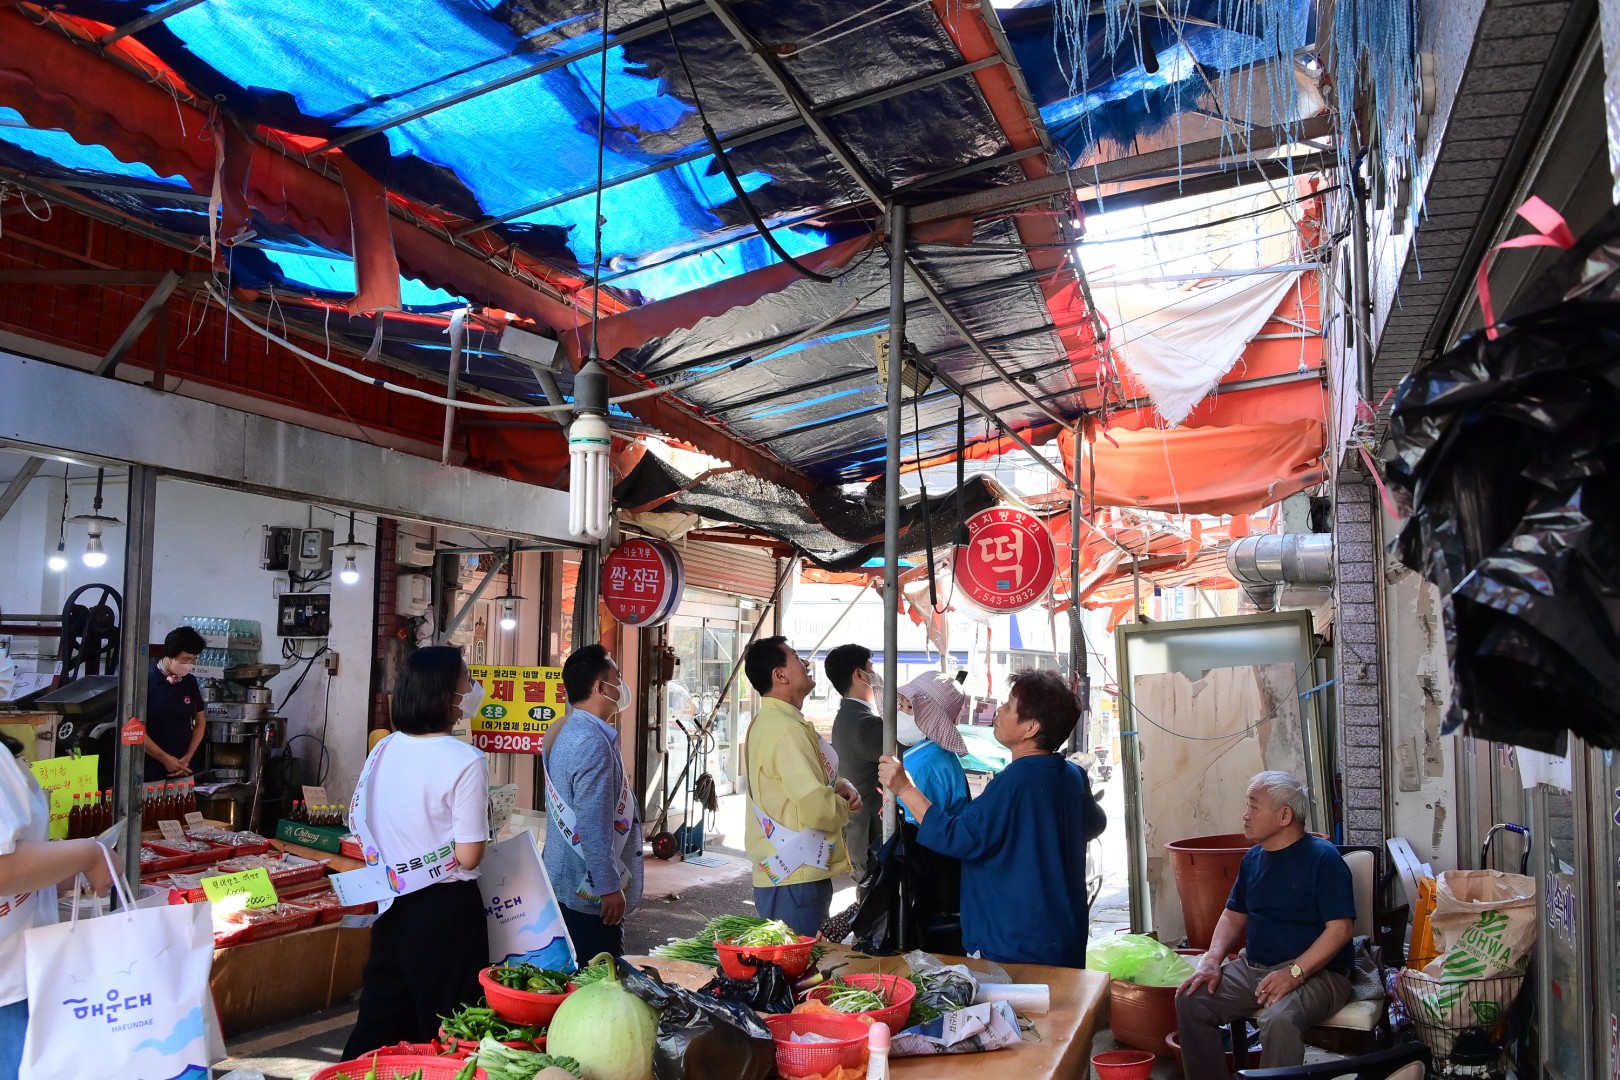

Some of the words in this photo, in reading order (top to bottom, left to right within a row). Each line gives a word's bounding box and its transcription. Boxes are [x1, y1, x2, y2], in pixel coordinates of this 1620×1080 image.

[968, 511, 1040, 535] 잔치방앗간
[623, 547, 651, 558] 미숫가루
[977, 527, 1024, 588] 떡
[972, 586, 1036, 605] T.543-8832
[493, 670, 517, 679] 필리핀
[523, 671, 539, 679] 네팔
[545, 672, 564, 680] 캄보
[485, 706, 504, 718] 초혼
[532, 707, 552, 720] 재혼
[294, 827, 320, 844] Chilsung
[1462, 926, 1511, 963] YUHWA
[62, 989, 152, 1024] 해운대
[112, 1018, 154, 1033] HAEUNDAE
